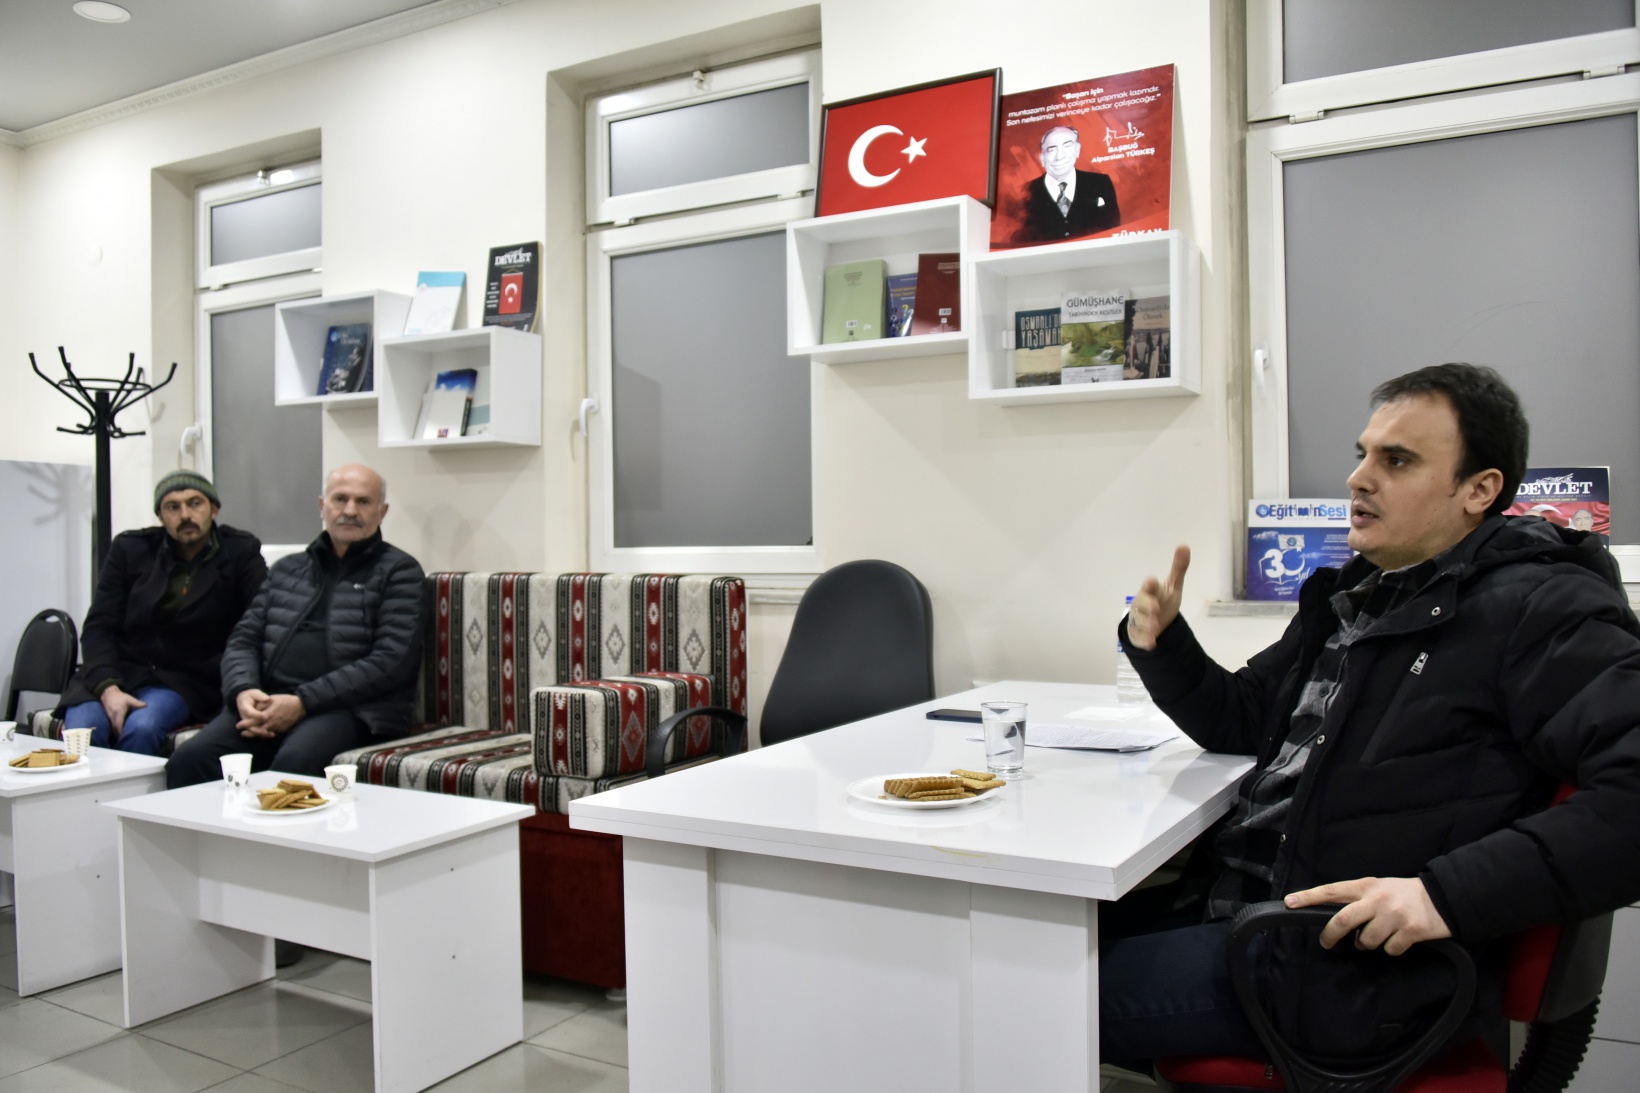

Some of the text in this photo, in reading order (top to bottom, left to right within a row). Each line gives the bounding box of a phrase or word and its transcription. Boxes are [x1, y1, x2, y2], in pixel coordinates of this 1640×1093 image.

[1008, 106, 1045, 118] muntazam
[1046, 102, 1066, 112] planlı
[1097, 91, 1128, 104] yapmak
[1021, 112, 1055, 124] nefesimizi
[1056, 107, 1090, 118] verinceye
[1091, 102, 1113, 112] kadar
[1107, 141, 1139, 153] BAŞBUĞ
[1091, 147, 1156, 164] Alparslan TÜRKEŞ
[494, 251, 532, 266] DEVLET
[1066, 295, 1125, 309] GÜMÜŞHANE
[1515, 481, 1593, 496] DEVLET
